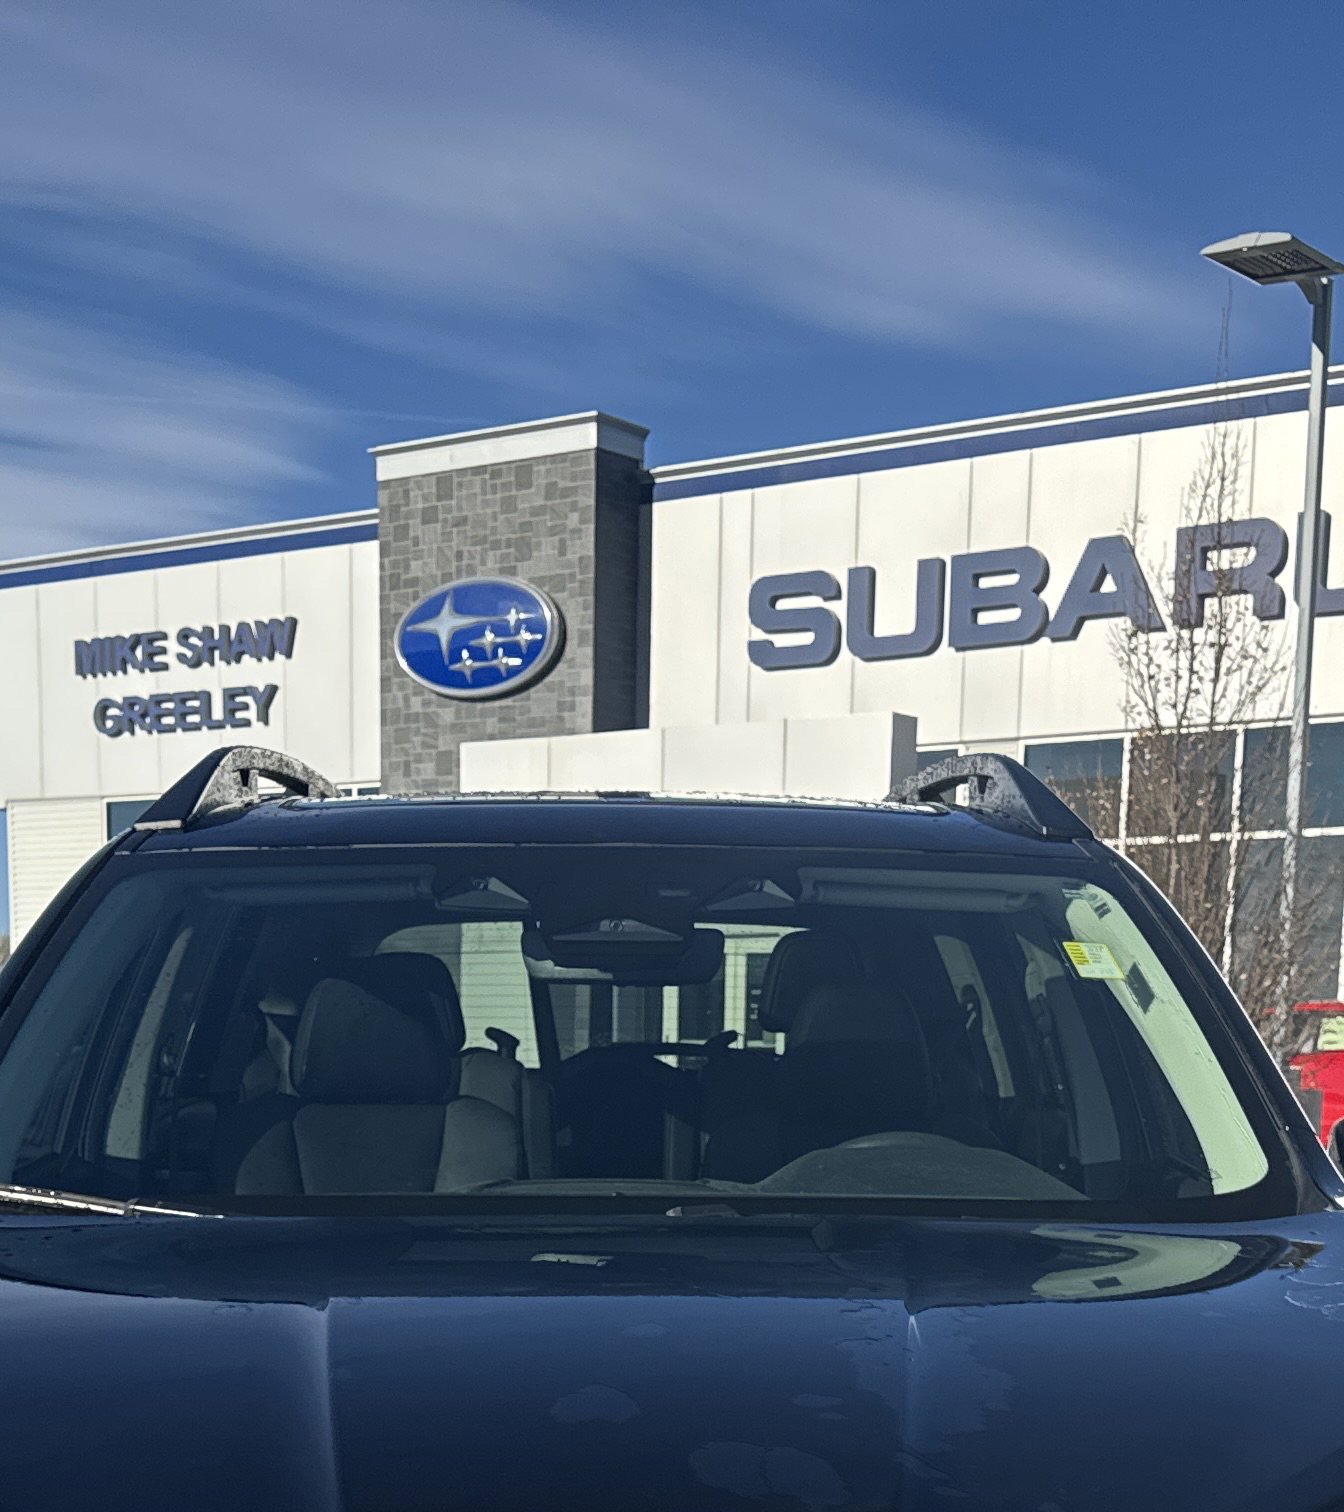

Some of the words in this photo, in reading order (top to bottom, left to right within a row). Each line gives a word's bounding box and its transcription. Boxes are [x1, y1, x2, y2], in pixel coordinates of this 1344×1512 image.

[74, 631, 169, 679] MIKE
[176, 616, 298, 669] SHAW
[93, 684, 279, 738] GREELEY
